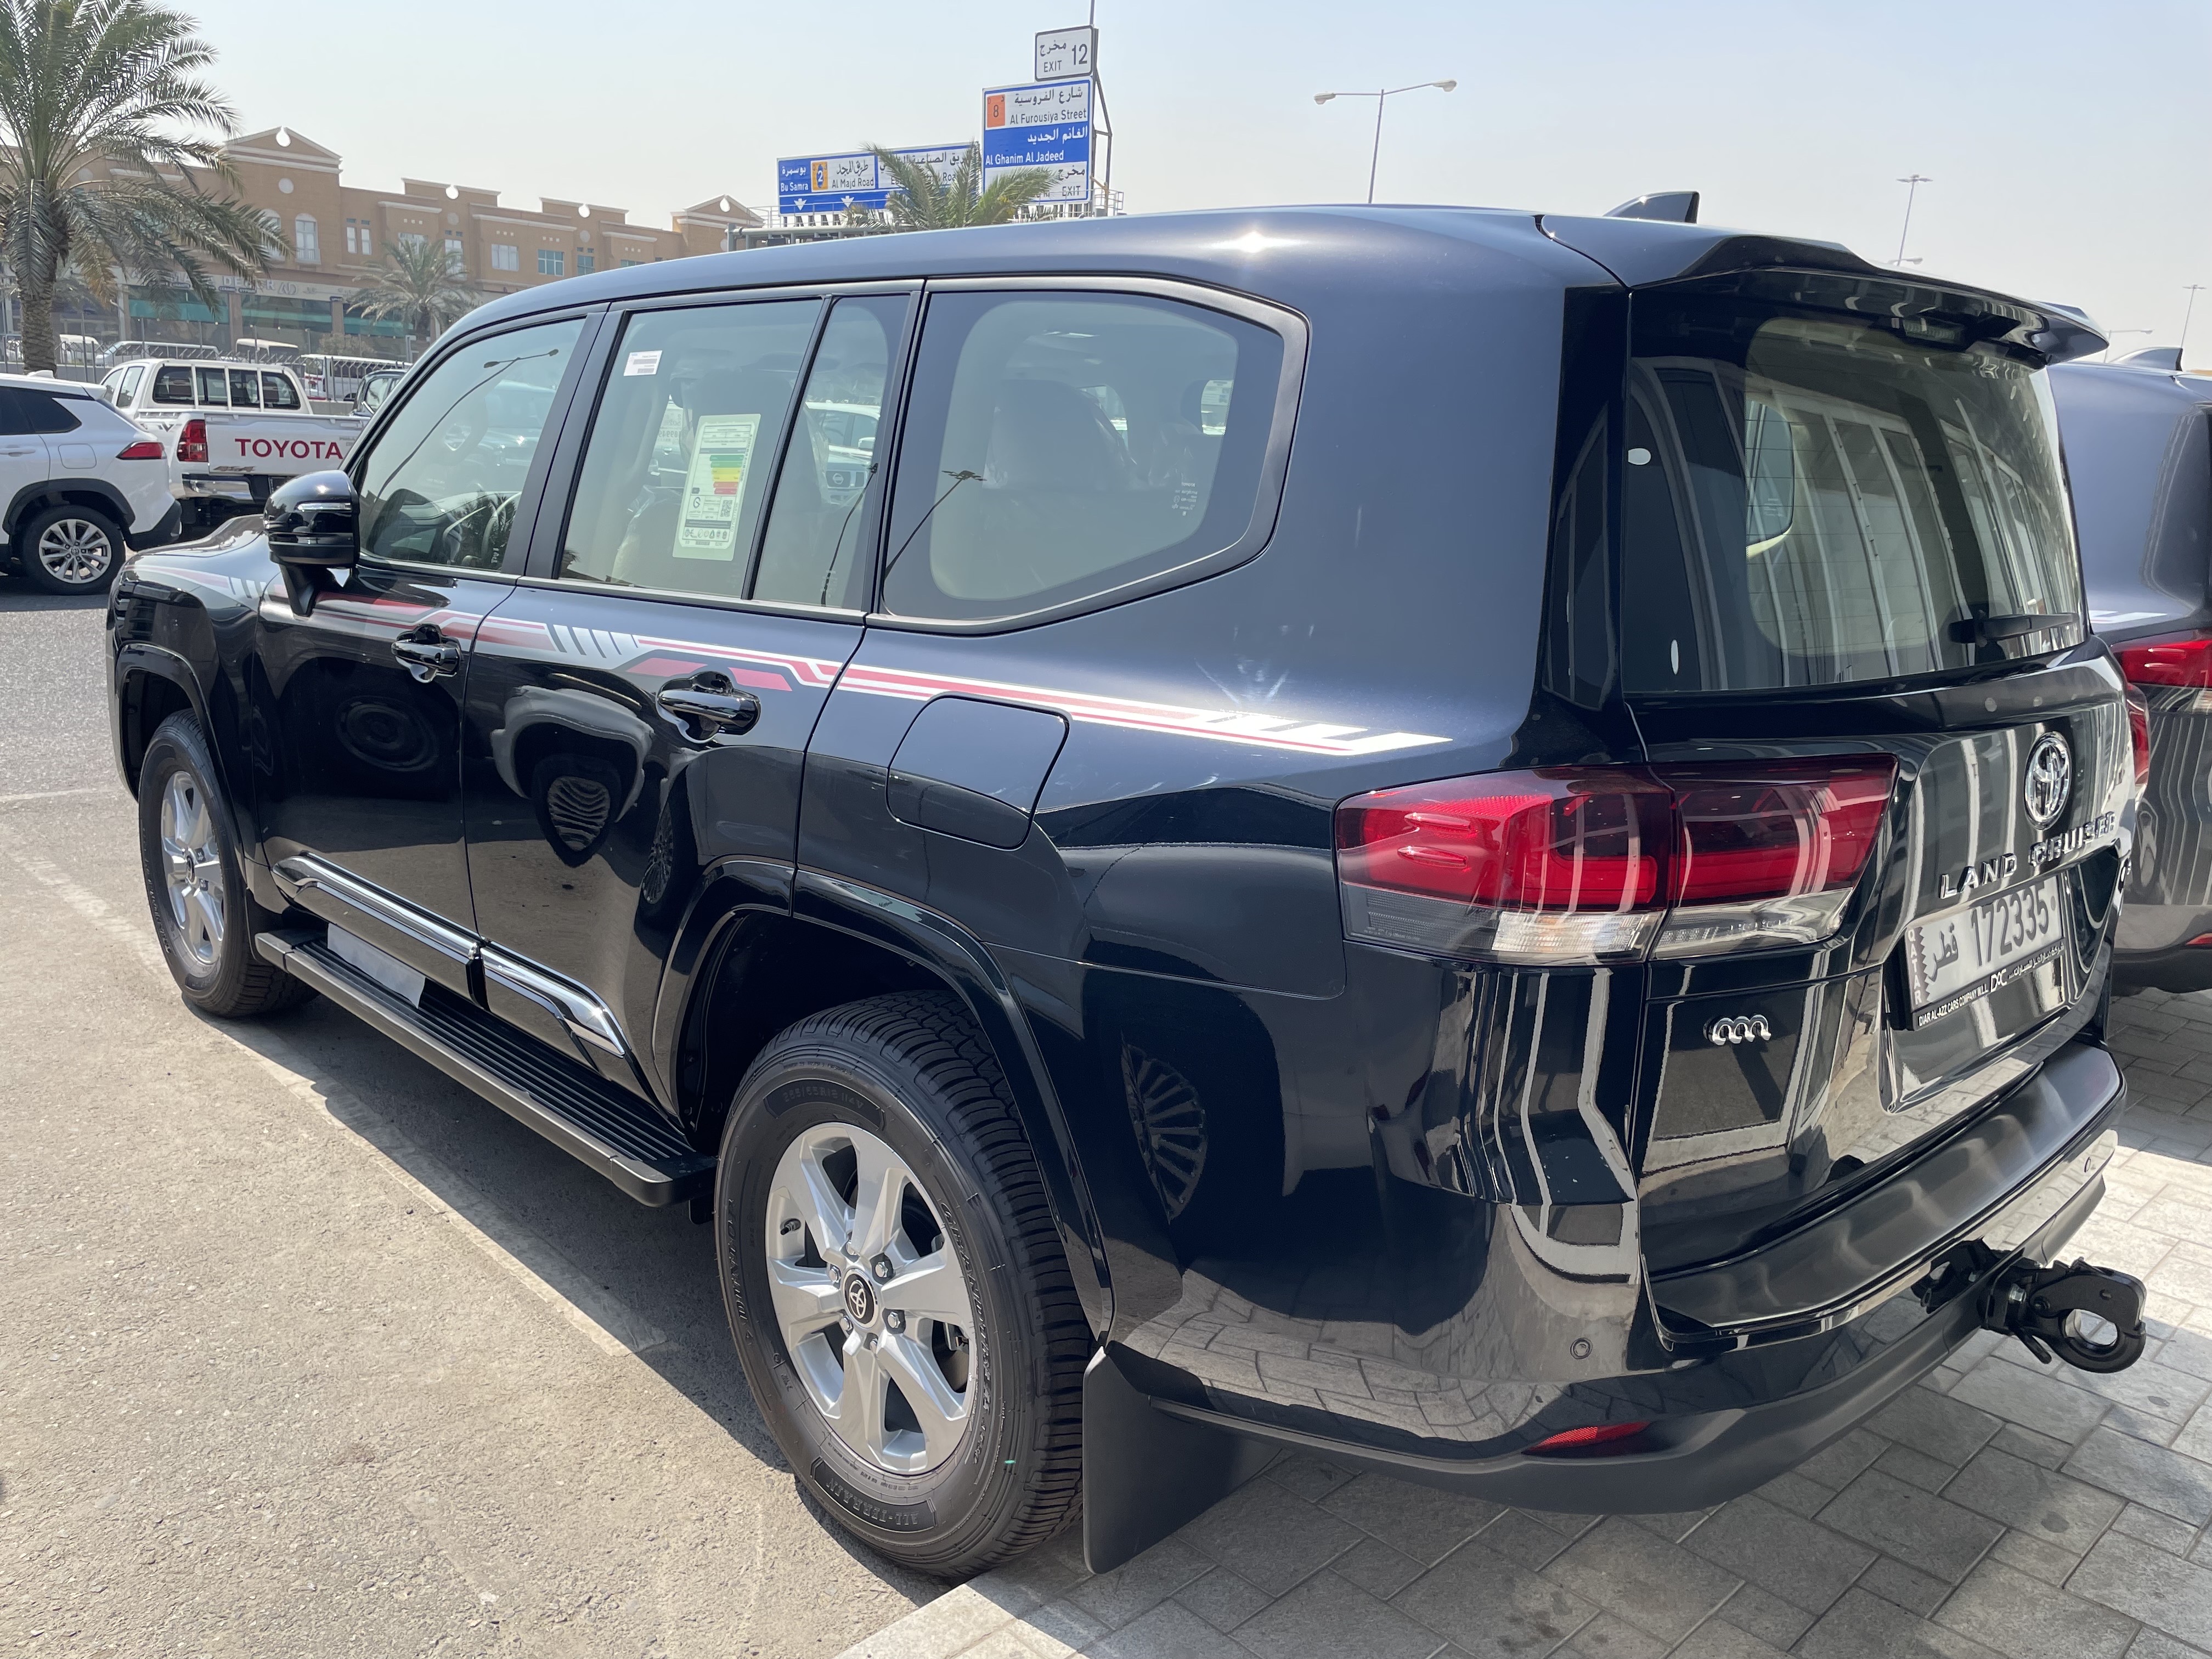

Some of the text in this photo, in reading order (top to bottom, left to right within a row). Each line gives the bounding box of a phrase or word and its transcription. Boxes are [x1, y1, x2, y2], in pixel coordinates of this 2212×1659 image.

[1040, 40, 1066, 57] مخرج
[1071, 44, 1087, 65] 12
[1043, 60, 1062, 72] EXIT
[1014, 86, 1083, 106] شارع الفروسية
[993, 104, 999, 118] 8
[1010, 108, 1087, 125] Al Furousiya Street
[1027, 125, 1088, 145] الغانم الجديد
[985, 150, 1064, 165] Al Ghanim Al Jadeed
[817, 170, 824, 182] 2
[832, 177, 874, 189] Al Majd Road
[943, 172, 957, 182] Roa
[780, 182, 809, 192] Bu Samra
[1062, 185, 1081, 197] EXIT
[235, 438, 343, 460] TOYOTA
[1938, 811, 2115, 900] LAND CRUISER
[1971, 881, 2049, 967] 172335
[1927, 922, 1959, 983] قطر
[1908, 929, 1922, 1005] QATAR
[1918, 1012, 1931, 1027] DIAR
[1931, 1004, 1948, 1021] AL-AZZ
[1947, 998, 1959, 1013] CARS
[1959, 989, 1977, 1007] COMPANY
[826, 1477, 919, 1526] ALL-TERRAIN
